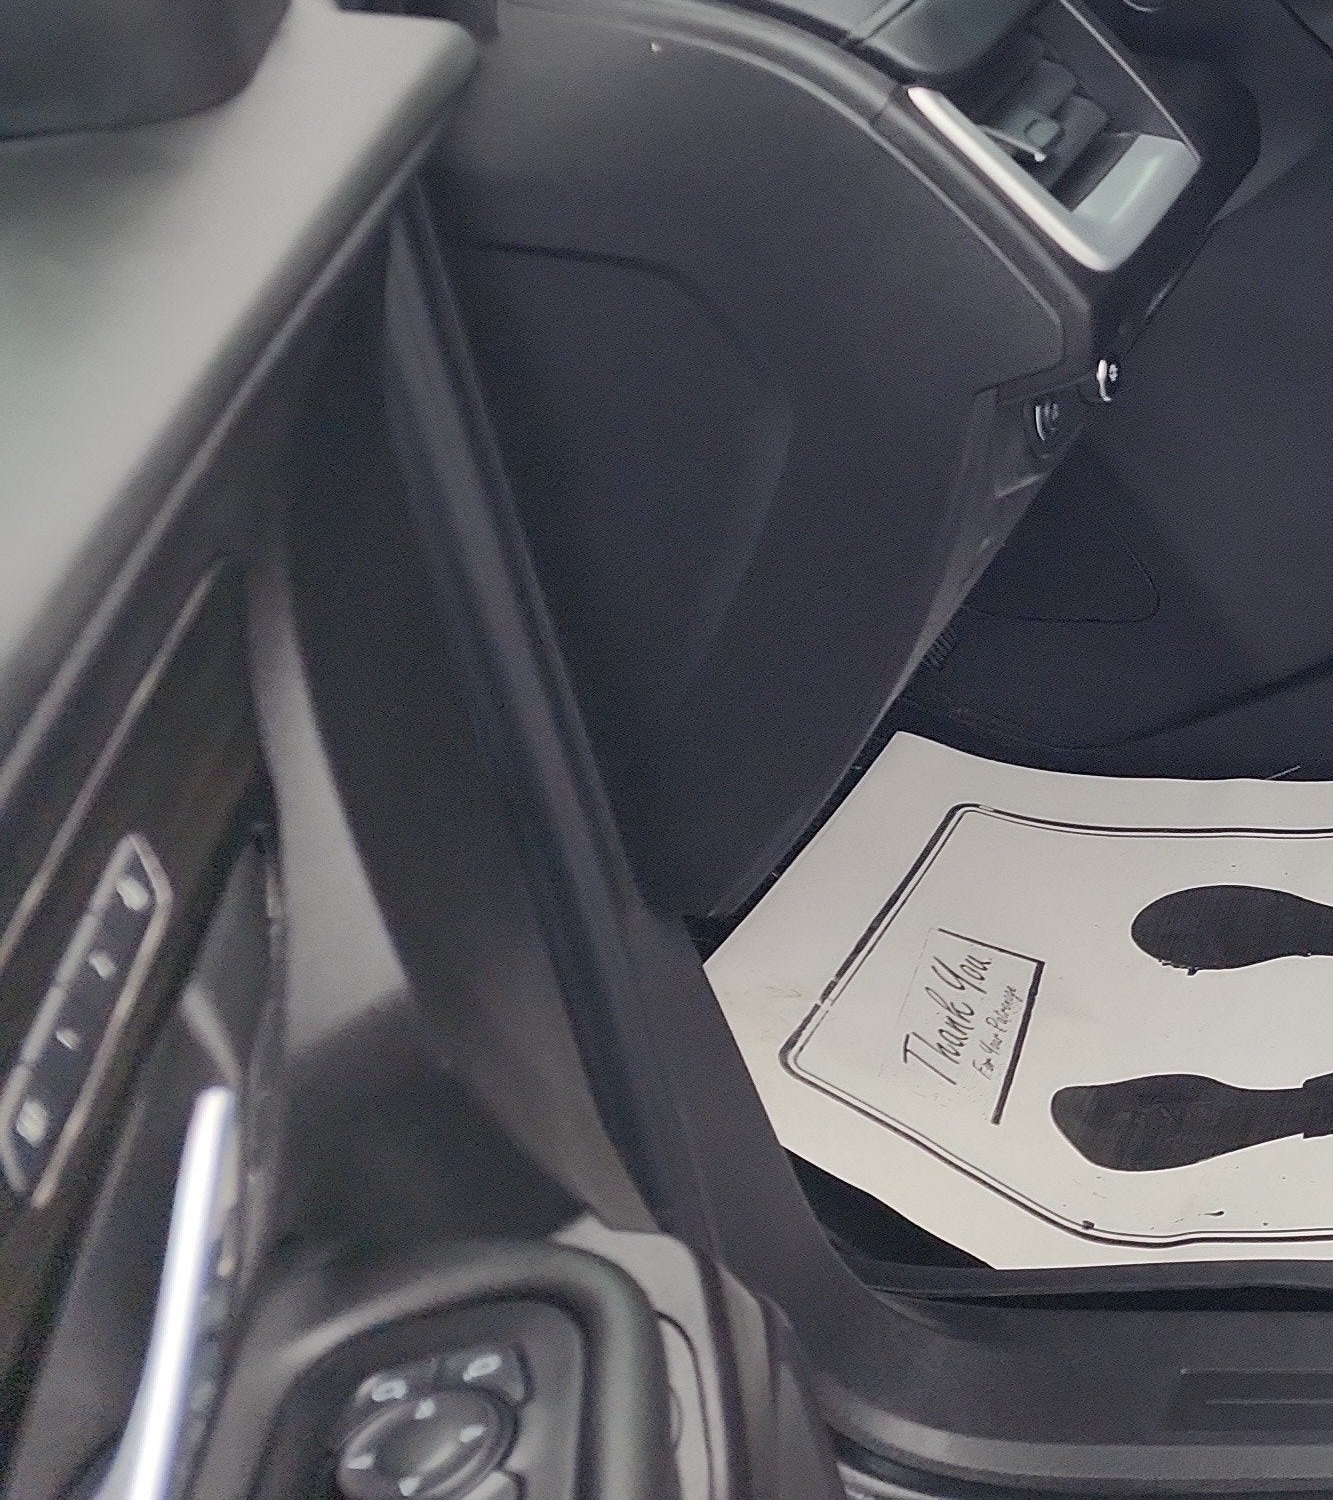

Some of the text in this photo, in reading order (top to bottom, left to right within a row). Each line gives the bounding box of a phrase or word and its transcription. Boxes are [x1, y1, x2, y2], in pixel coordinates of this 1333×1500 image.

[903, 955, 992, 1086] Thank You
[979, 1033, 1003, 1055] Your
[972, 1059, 994, 1080] For
